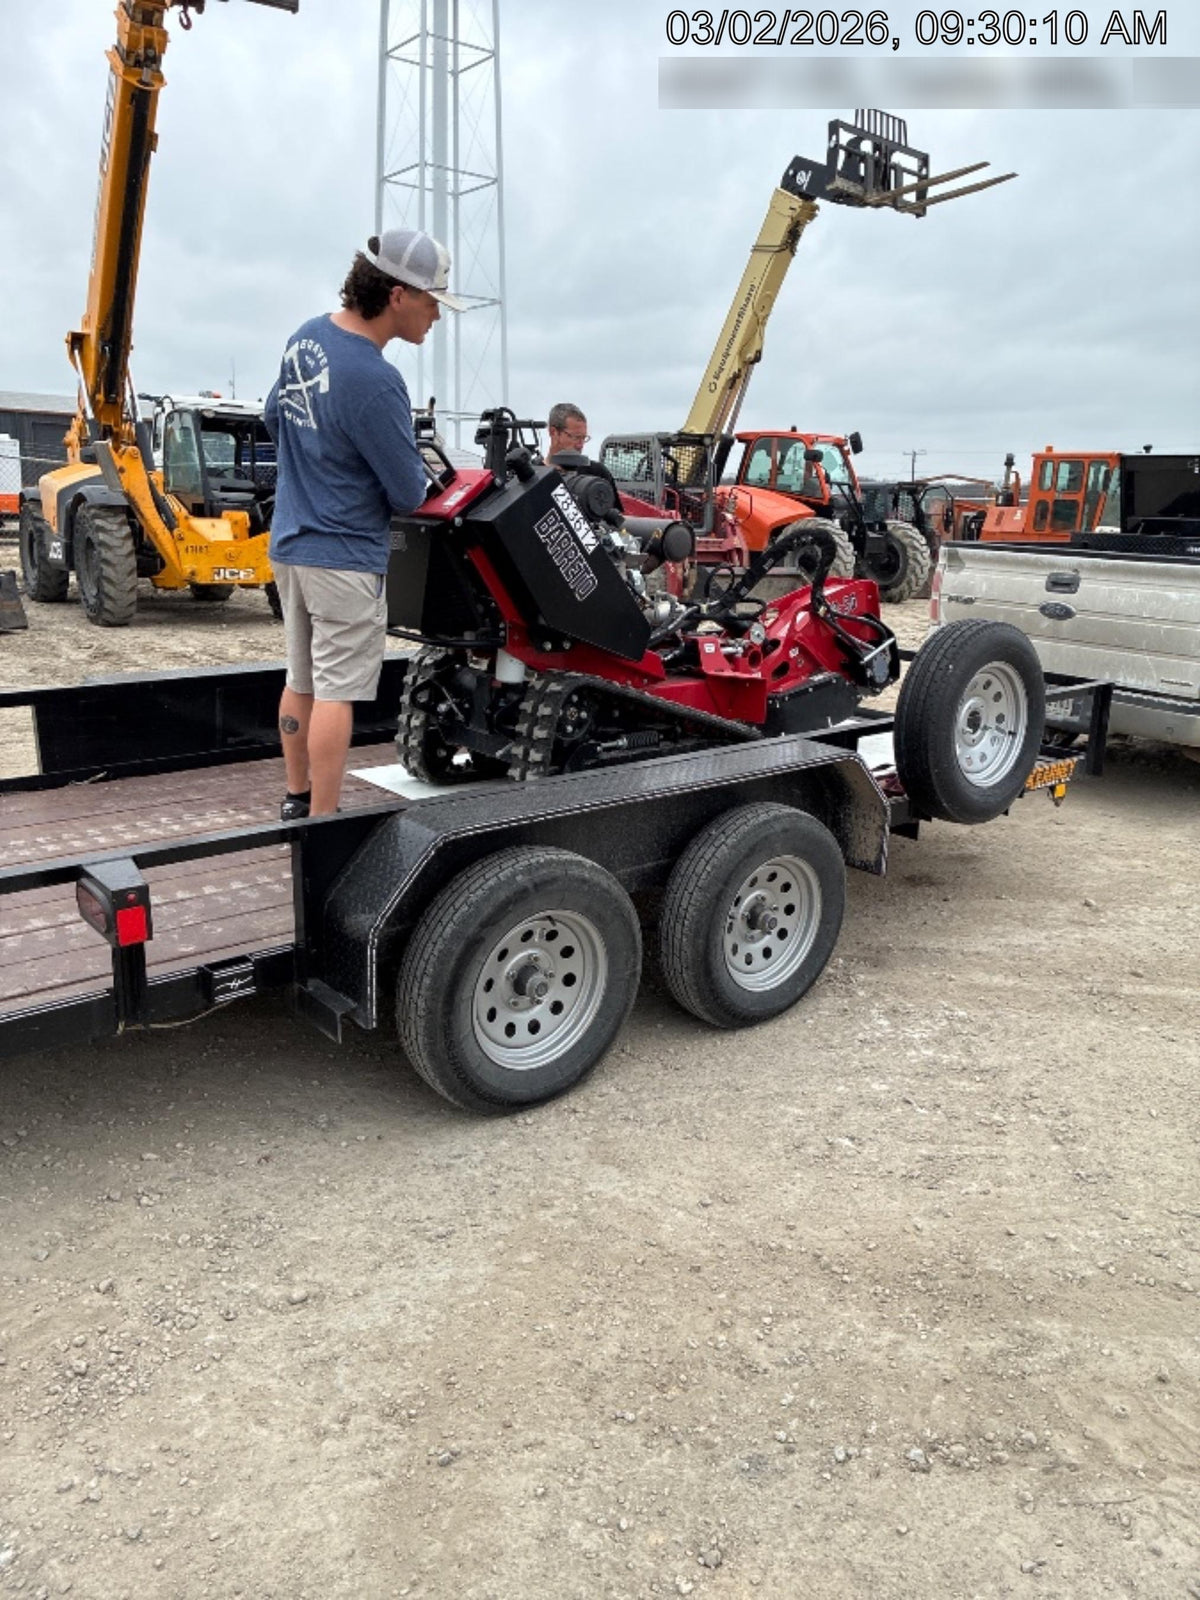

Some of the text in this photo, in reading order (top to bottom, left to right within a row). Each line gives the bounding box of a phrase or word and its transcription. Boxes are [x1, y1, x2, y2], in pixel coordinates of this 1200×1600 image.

[552, 484, 599, 554] 283612
[212, 567, 255, 581] JCB
[533, 507, 599, 602] BARRETO
